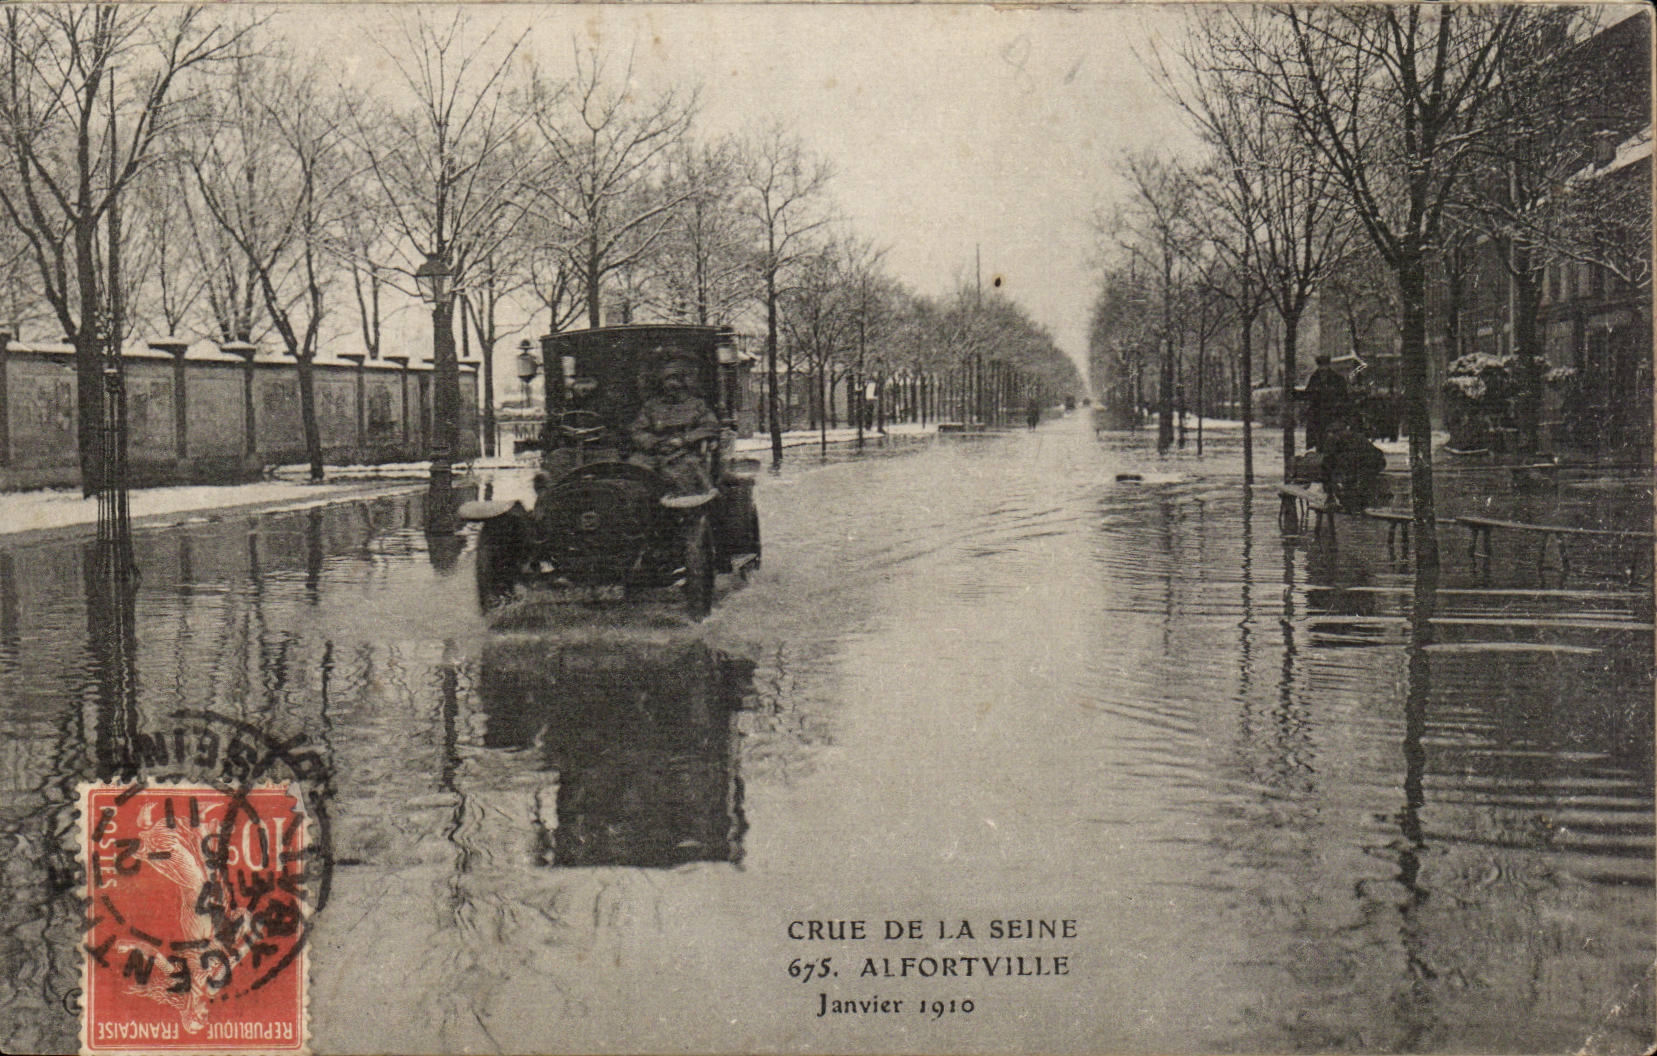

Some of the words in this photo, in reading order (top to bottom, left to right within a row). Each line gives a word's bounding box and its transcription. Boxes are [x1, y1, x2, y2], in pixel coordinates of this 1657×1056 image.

[98, 804, 119, 890] POSTES
[97, 1019, 179, 1040] FRANÇAISE
[206, 1020, 293, 1041] REPUBLIQUE
